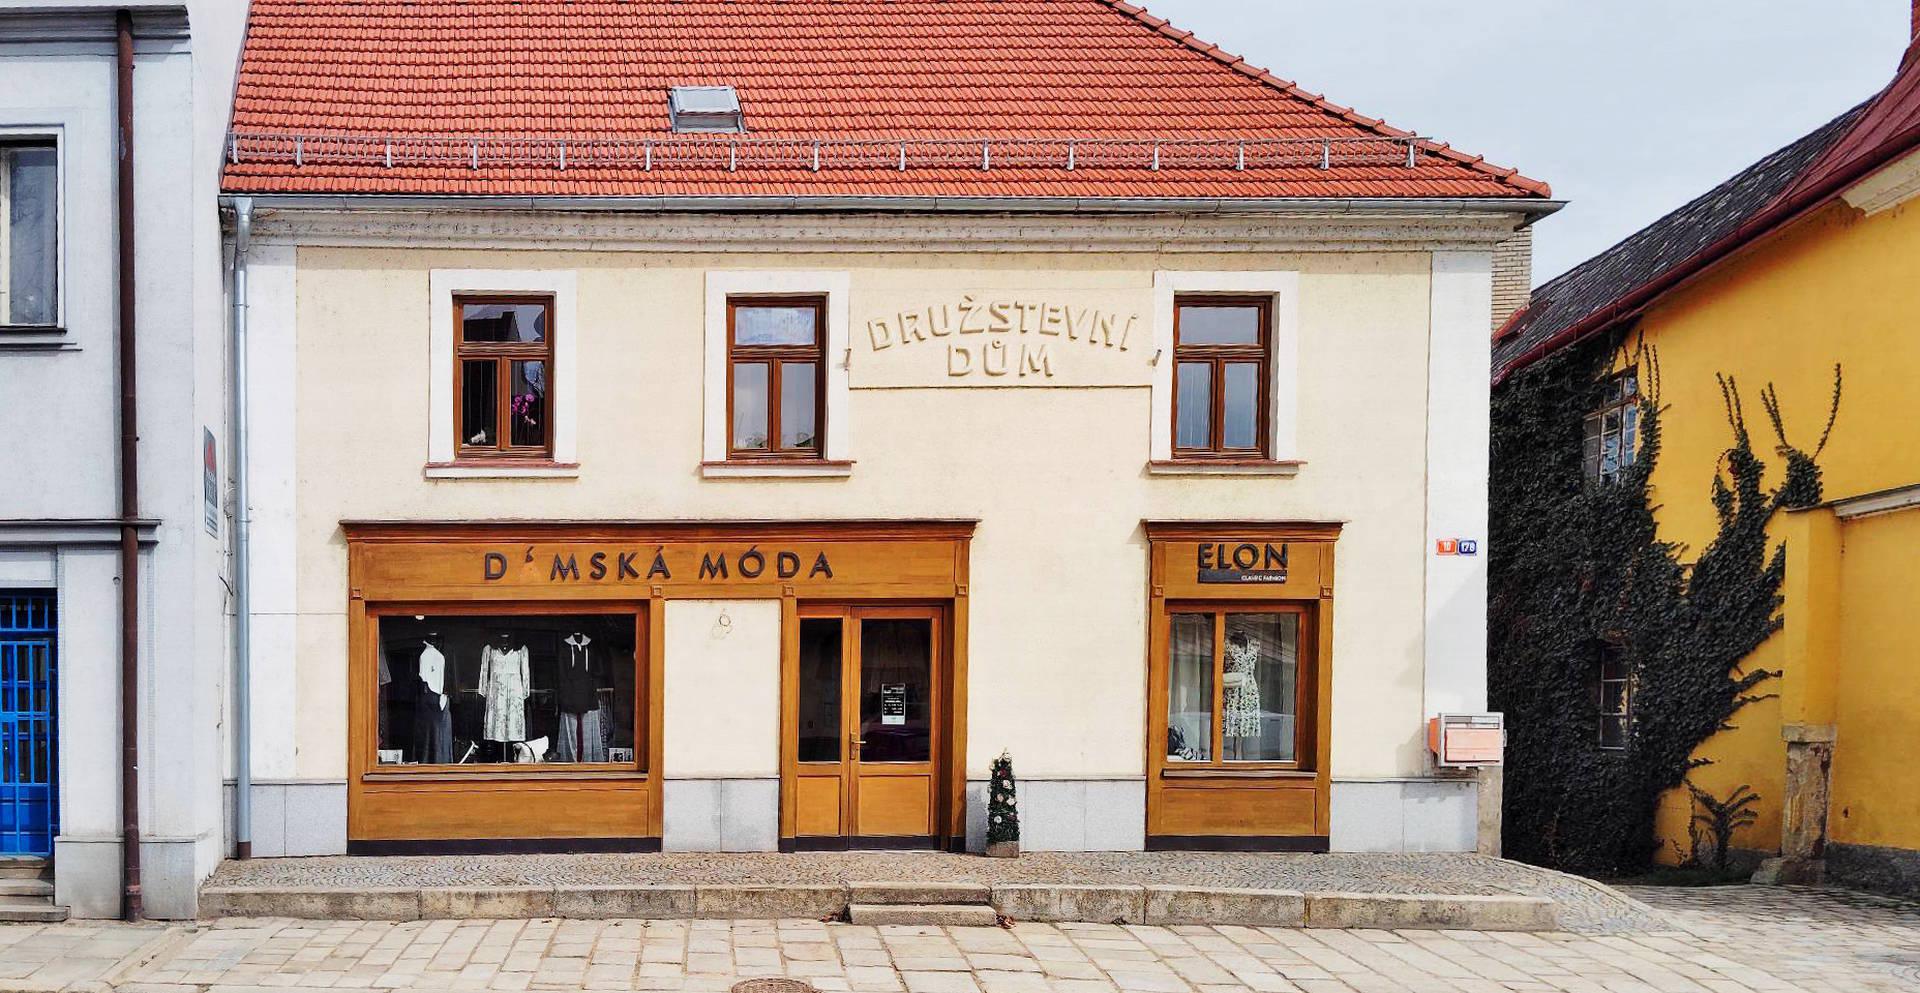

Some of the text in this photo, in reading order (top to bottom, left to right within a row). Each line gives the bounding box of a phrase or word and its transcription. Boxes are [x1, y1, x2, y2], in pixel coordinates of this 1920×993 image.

[867, 295, 1139, 352] DRUŽSTEVNÍ
[947, 339, 1054, 377] DŮM
[698, 545, 834, 580] MÓDA
[1198, 543, 1288, 569] ELON
[1461, 542, 1476, 552] 178
